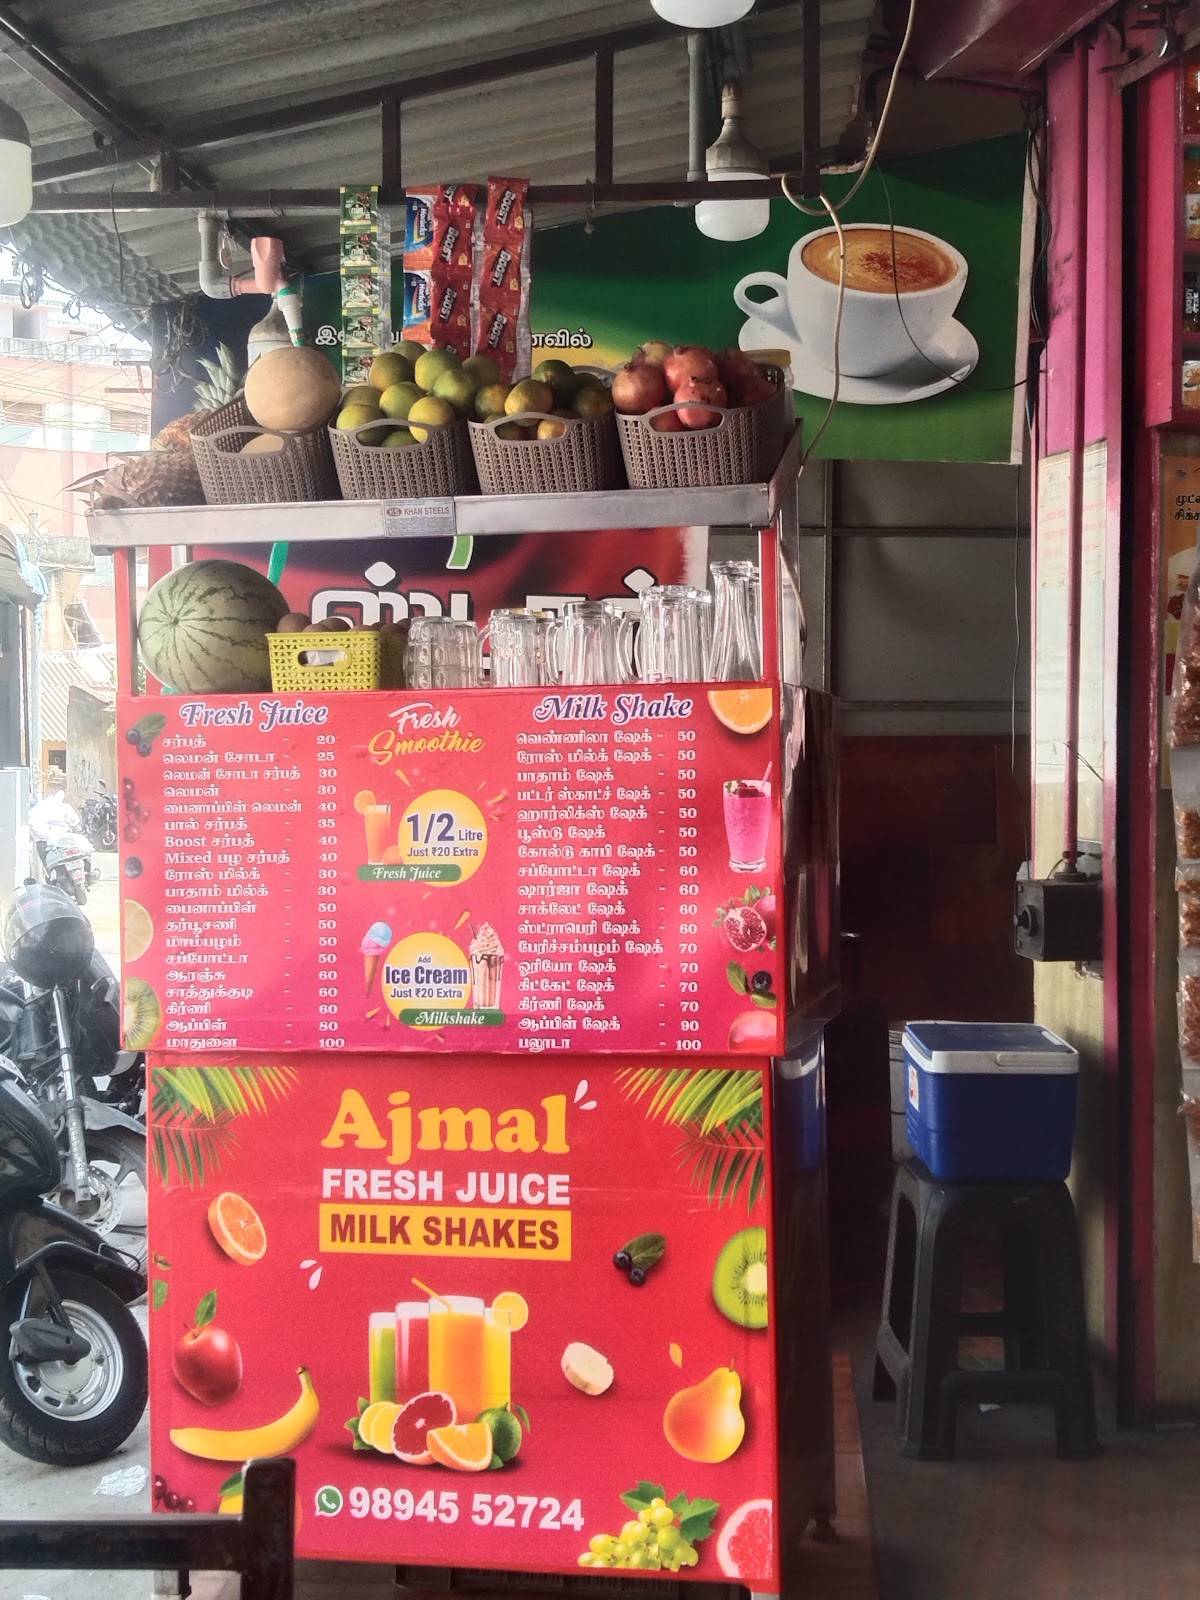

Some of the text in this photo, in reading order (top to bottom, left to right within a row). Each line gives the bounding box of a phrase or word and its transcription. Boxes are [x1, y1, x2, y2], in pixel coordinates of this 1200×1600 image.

[442, 227, 459, 262] BOOST
[492, 250, 512, 287] BOOST
[488, 314, 508, 348] BOOST
[404, 507, 422, 516] KHAN
[424, 507, 449, 516] STEELS
[180, 700, 328, 731] Fresh Juice
[534, 692, 692, 724] Milk Shake
[388, 702, 462, 734] Fresh
[162, 734, 335, 749] சர்பத் 20
[516, 728, 696, 745] வெண்ணிலா ஷேக் 50
[368, 730, 486, 766] Smoothie
[517, 747, 695, 765] ரோஸ் மில்க் ஷேக் 50
[163, 751, 335, 764] லெமன் சோடா 25
[163, 766, 337, 780] லெமன் சோடா சர்பத் 30
[517, 767, 696, 784] பாதாம் ஷேக் 50
[164, 784, 336, 797] லெமன் 30
[518, 785, 696, 802] பட்டர் ஸ்காட்ச் ஷேக் 50
[251, 799, 301, 813] லெமன்
[318, 802, 336, 811] 40
[610, 805, 647, 822] ஷேக்
[679, 808, 697, 818] 50
[165, 817, 335, 831] பால் சர்பத் 35
[407, 812, 483, 844] 1/2 Litre
[568, 824, 605, 841] ஷேக்
[679, 827, 697, 838] 50
[164, 833, 337, 848] Boost சர்பத் 40
[165, 850, 337, 866] Mixed பழ சர்பத் 40
[407, 847, 478, 857] Just ₹20 Extra
[518, 843, 697, 860] கோல்டு காபி ஷேக் 50
[165, 867, 336, 882] ரோஸ் மில்க் 30
[372, 866, 442, 882] Fresh Juice
[518, 862, 697, 879] சப்போட்டா ஷேக் 60
[165, 883, 336, 899] பாதாம் மில்க் 30
[518, 880, 699, 898] ஷார்ஜா ஷேக் 60
[318, 903, 336, 912] 50
[518, 900, 697, 917] சாக்லேட் ஷேக் 60
[166, 918, 336, 934] தர்பூசணி 50
[602, 920, 640, 937] ஷேக்
[679, 923, 697, 934] 60
[166, 934, 337, 950] மாம்பழம் 50
[625, 939, 663, 956] ஷேக்
[679, 943, 697, 954] 70
[166, 952, 337, 964] சப்போட்டா 50
[418, 956, 432, 964] Add
[579, 958, 616, 975] ஷேக்
[680, 963, 698, 973] 70
[166, 968, 337, 982] ஆரஞ்சு 60
[386, 966, 468, 984] Ice Cream
[166, 985, 338, 1000] சாத்துக்குடி 60
[390, 988, 462, 998] Just ₹20 Extra
[518, 977, 698, 994] கிட்கேட் ஷேக் 70
[168, 1001, 338, 1015] கிர்ணி 60
[518, 996, 699, 1013] கிர்ணி ஷேக் 70
[167, 1018, 338, 1032] ஆப்பிள் 80
[415, 1012, 484, 1025] Milkshake
[518, 1015, 699, 1033] ஆப்பிள் ஷேக் 90
[165, 1038, 344, 1049] மாதுளை 100
[676, 1040, 701, 1051] 100
[320, 1088, 570, 1165] Ajmal
[322, 1168, 570, 1205] FRESH JUICE
[330, 1214, 560, 1250] MILK SHAKES
[349, 1486, 584, 1531] 98945 52724
